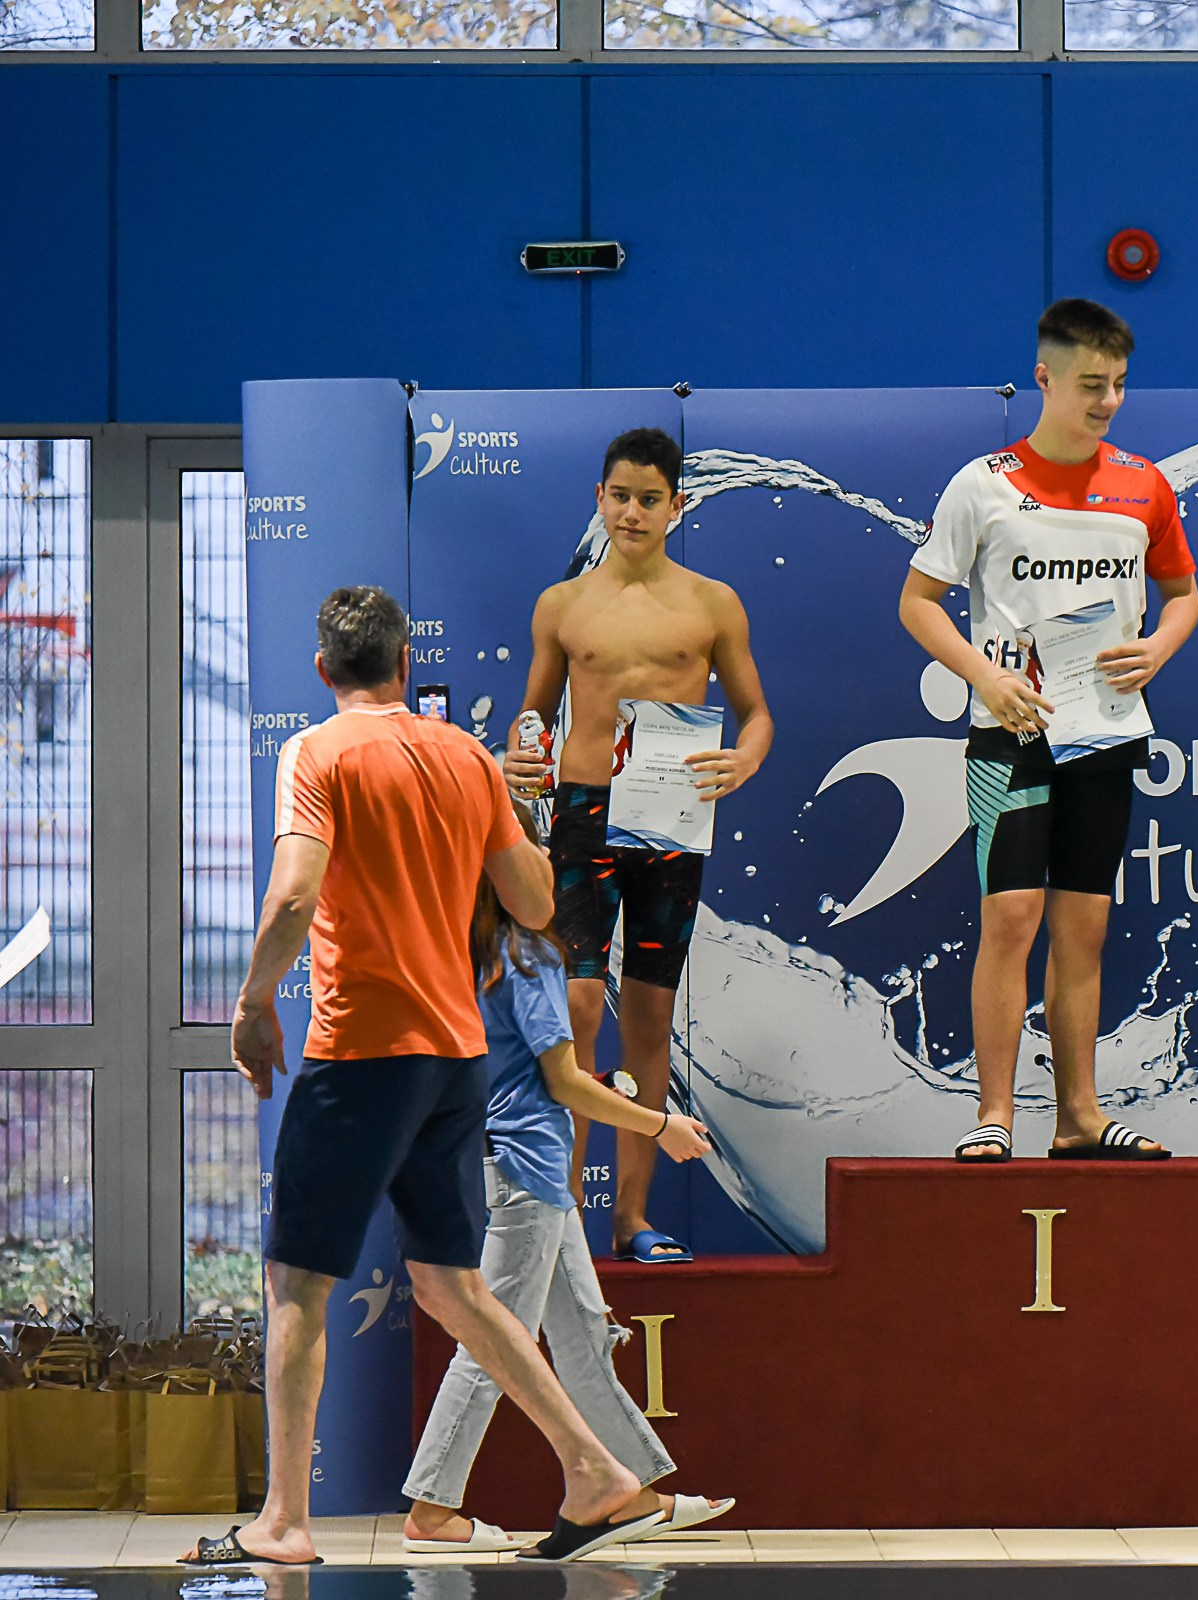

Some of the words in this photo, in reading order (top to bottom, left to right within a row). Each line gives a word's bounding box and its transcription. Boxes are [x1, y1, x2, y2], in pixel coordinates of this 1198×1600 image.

[547, 250, 596, 266] EXIT
[457, 431, 519, 448] SPORTS
[450, 451, 522, 475] Culture
[248, 495, 307, 514] SPORTS
[1018, 503, 1042, 512] PEAK
[246, 517, 309, 541] ulture
[252, 712, 310, 730] SPORTS
[1021, 1208, 1067, 1312] I
